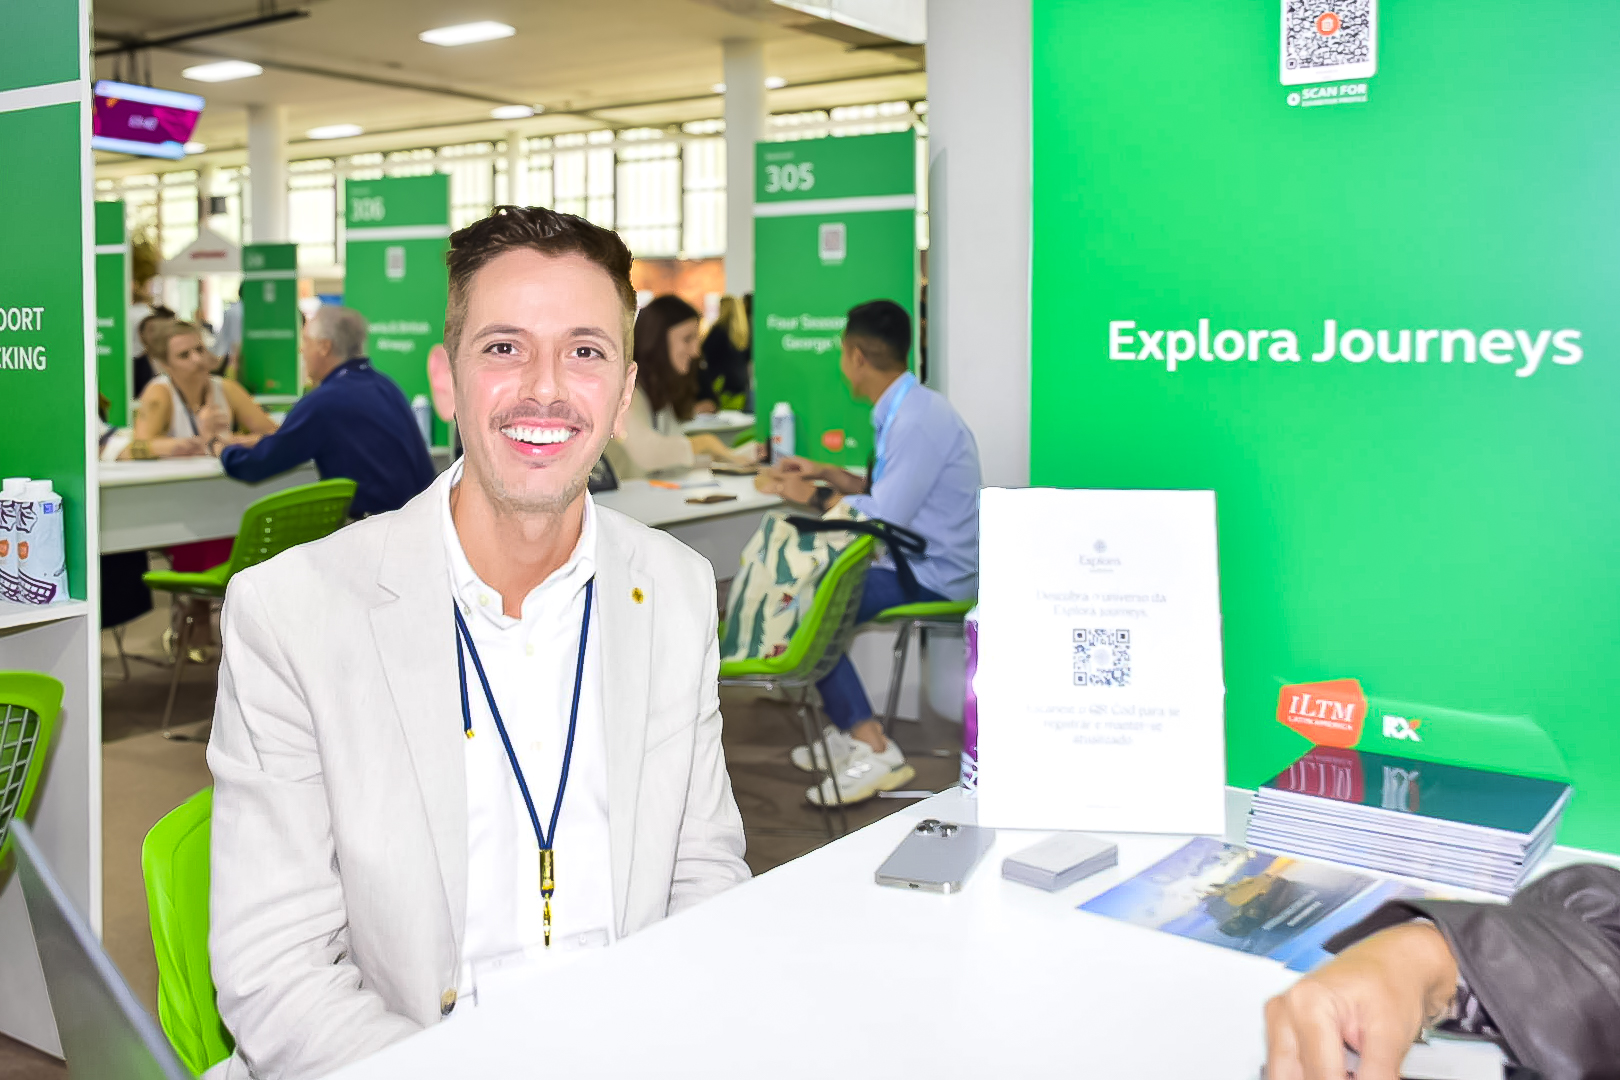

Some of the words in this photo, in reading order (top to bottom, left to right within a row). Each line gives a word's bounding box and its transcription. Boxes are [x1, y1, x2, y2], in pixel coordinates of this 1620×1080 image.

[1301, 86, 1338, 100] SCAN
[1339, 83, 1367, 96] FOR
[764, 162, 815, 194] 305
[0, 346, 47, 371] KING
[1108, 318, 1300, 372] Explora
[1311, 318, 1584, 378] Journeys
